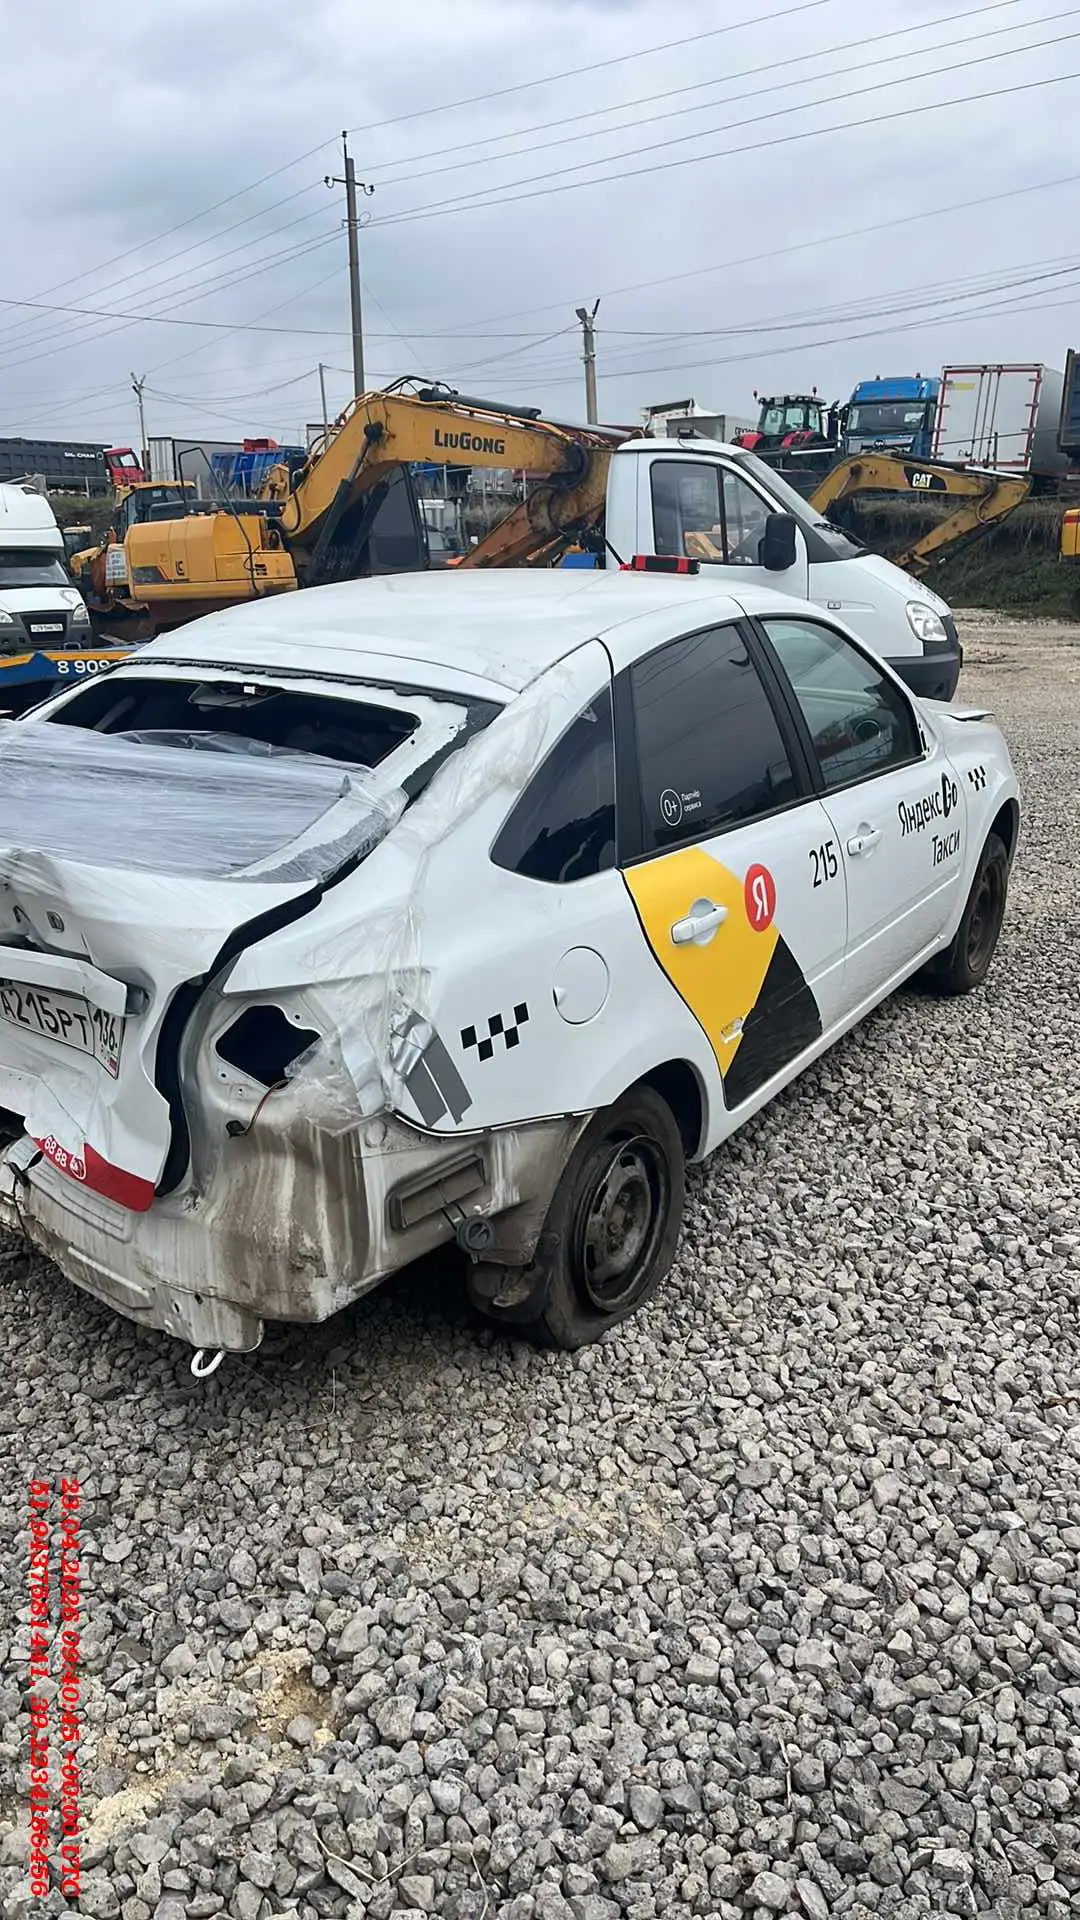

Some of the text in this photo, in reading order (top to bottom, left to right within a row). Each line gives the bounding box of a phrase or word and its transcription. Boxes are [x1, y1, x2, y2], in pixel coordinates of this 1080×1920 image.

[912, 472, 932, 488] CAT
[57, 660, 70, 674] 8
[664, 800, 678, 817] 0+
[897, 772, 958, 836] Яндекс Go
[809, 840, 838, 888] 215
[932, 829, 960, 867] Такси
[753, 875, 769, 922] Я
[93, 1008, 116, 1052] 136
